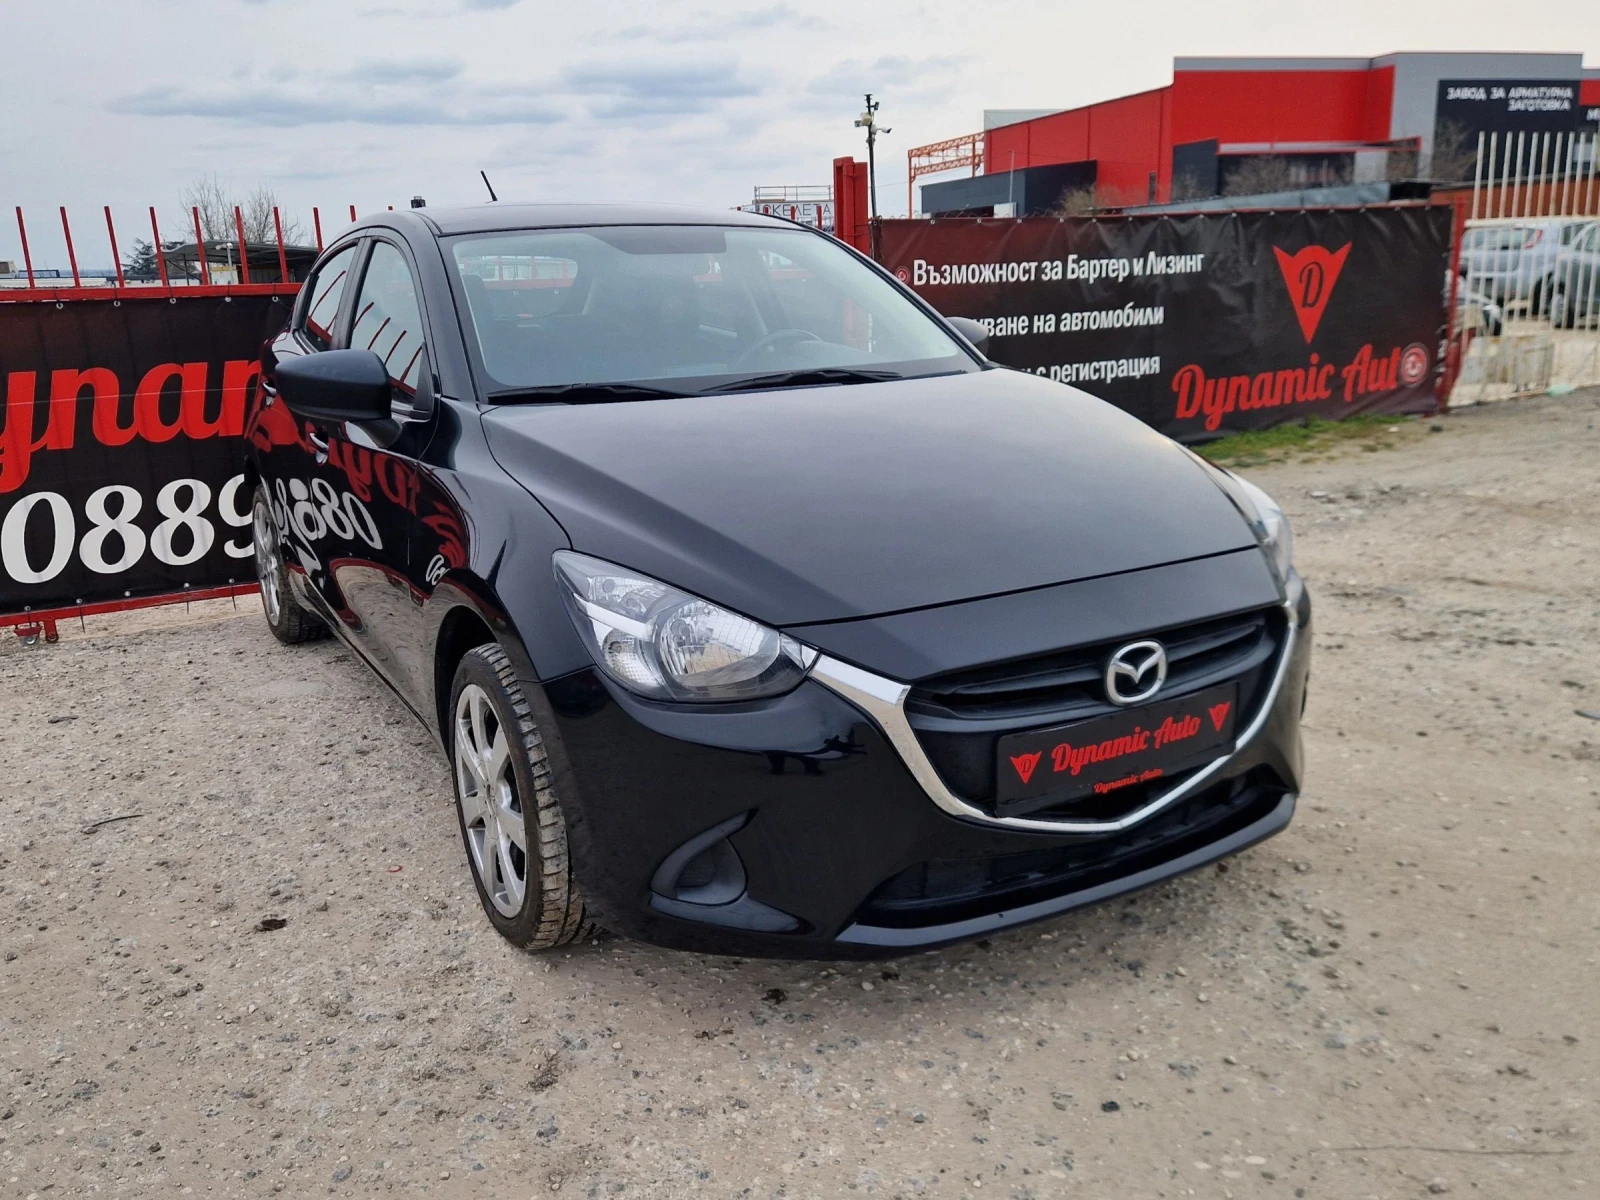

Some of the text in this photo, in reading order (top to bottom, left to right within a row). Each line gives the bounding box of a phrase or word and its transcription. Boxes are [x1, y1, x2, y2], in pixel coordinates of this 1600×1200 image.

[1447, 87, 1573, 101] ЗАВОД ЗА АРМАТУРНА
[1508, 99, 1571, 111] ЗАГОТОВКА
[913, 251, 1205, 285] Възможност за Бартер и Лизинг
[1033, 315, 1055, 334] на
[1060, 302, 1164, 332] автомобили
[1050, 356, 1160, 383] регистрация
[1172, 352, 1335, 432] Dynamic
[1051, 715, 1201, 776] Dynamic Auto
[1093, 768, 1163, 794] Dynamic Auto
